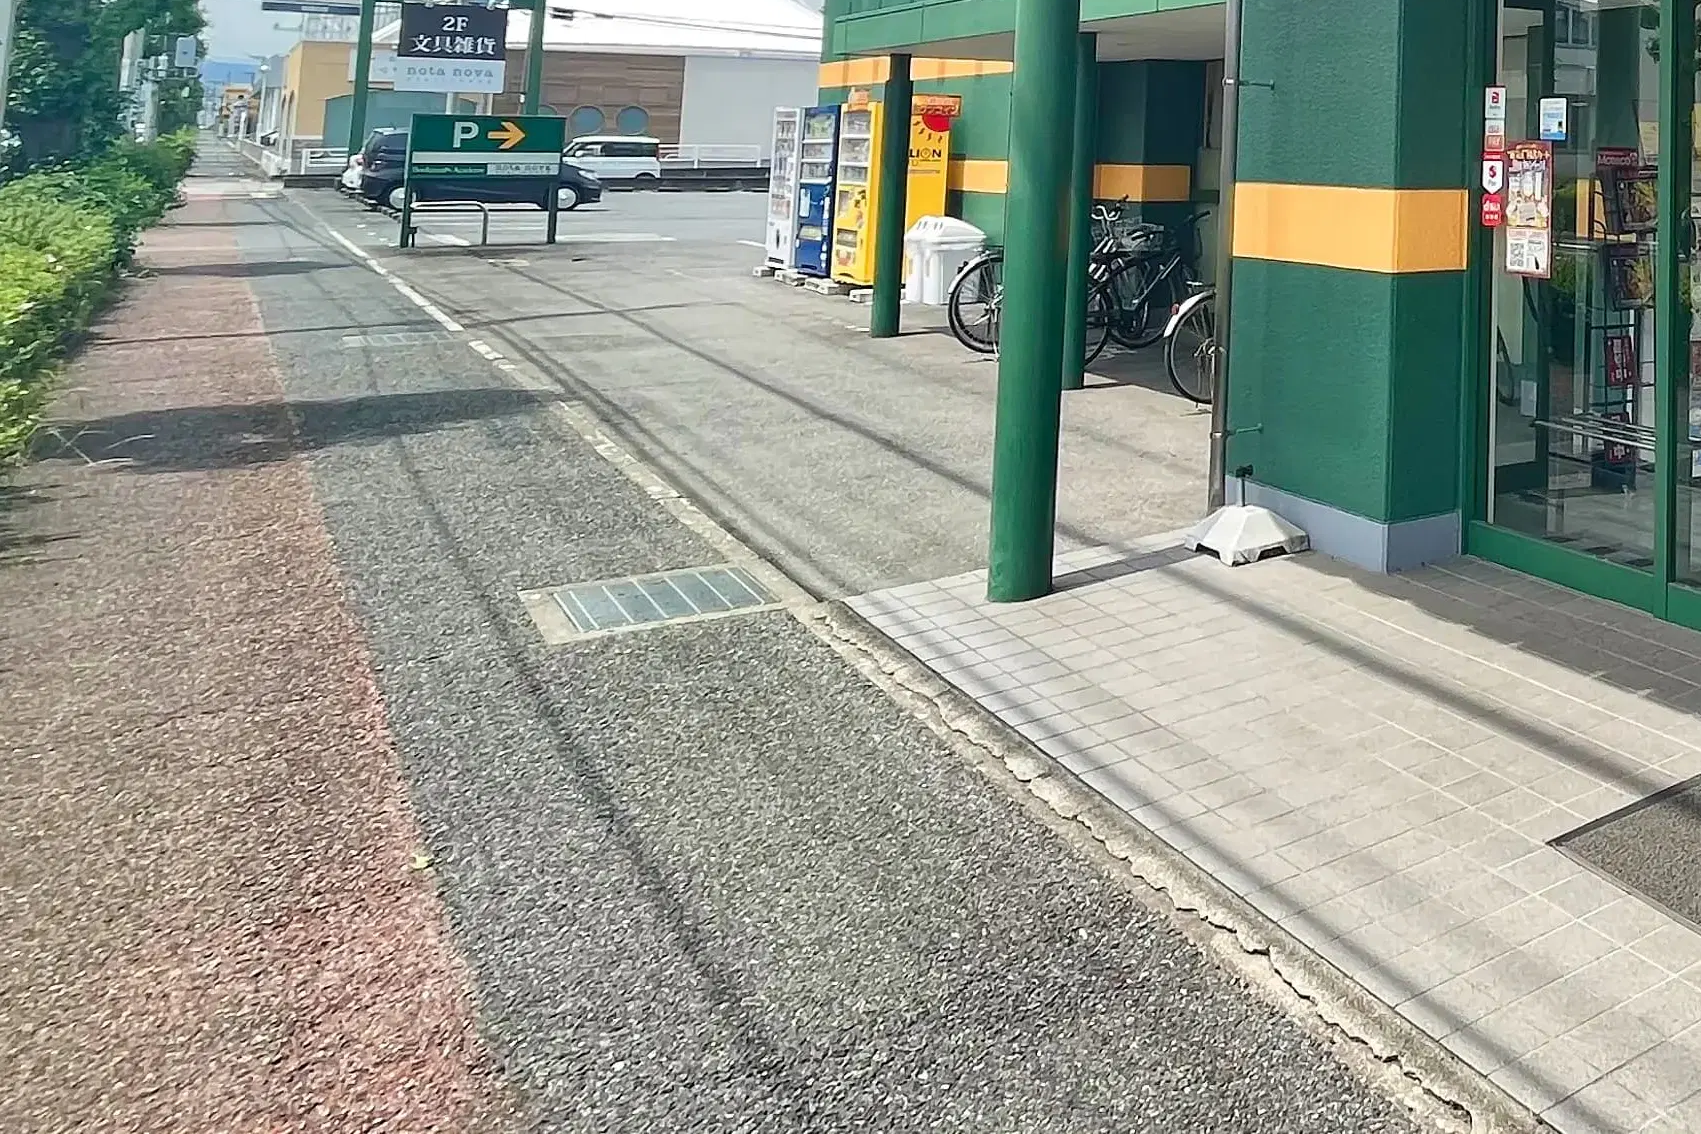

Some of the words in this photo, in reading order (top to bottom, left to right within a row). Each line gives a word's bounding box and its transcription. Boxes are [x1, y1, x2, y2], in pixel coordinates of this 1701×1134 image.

[442, 16, 469, 32] 2F
[409, 34, 496, 55] 文具雑貨
[407, 66, 446, 77] nota
[453, 68, 494, 78] nova
[452, 121, 479, 148] P
